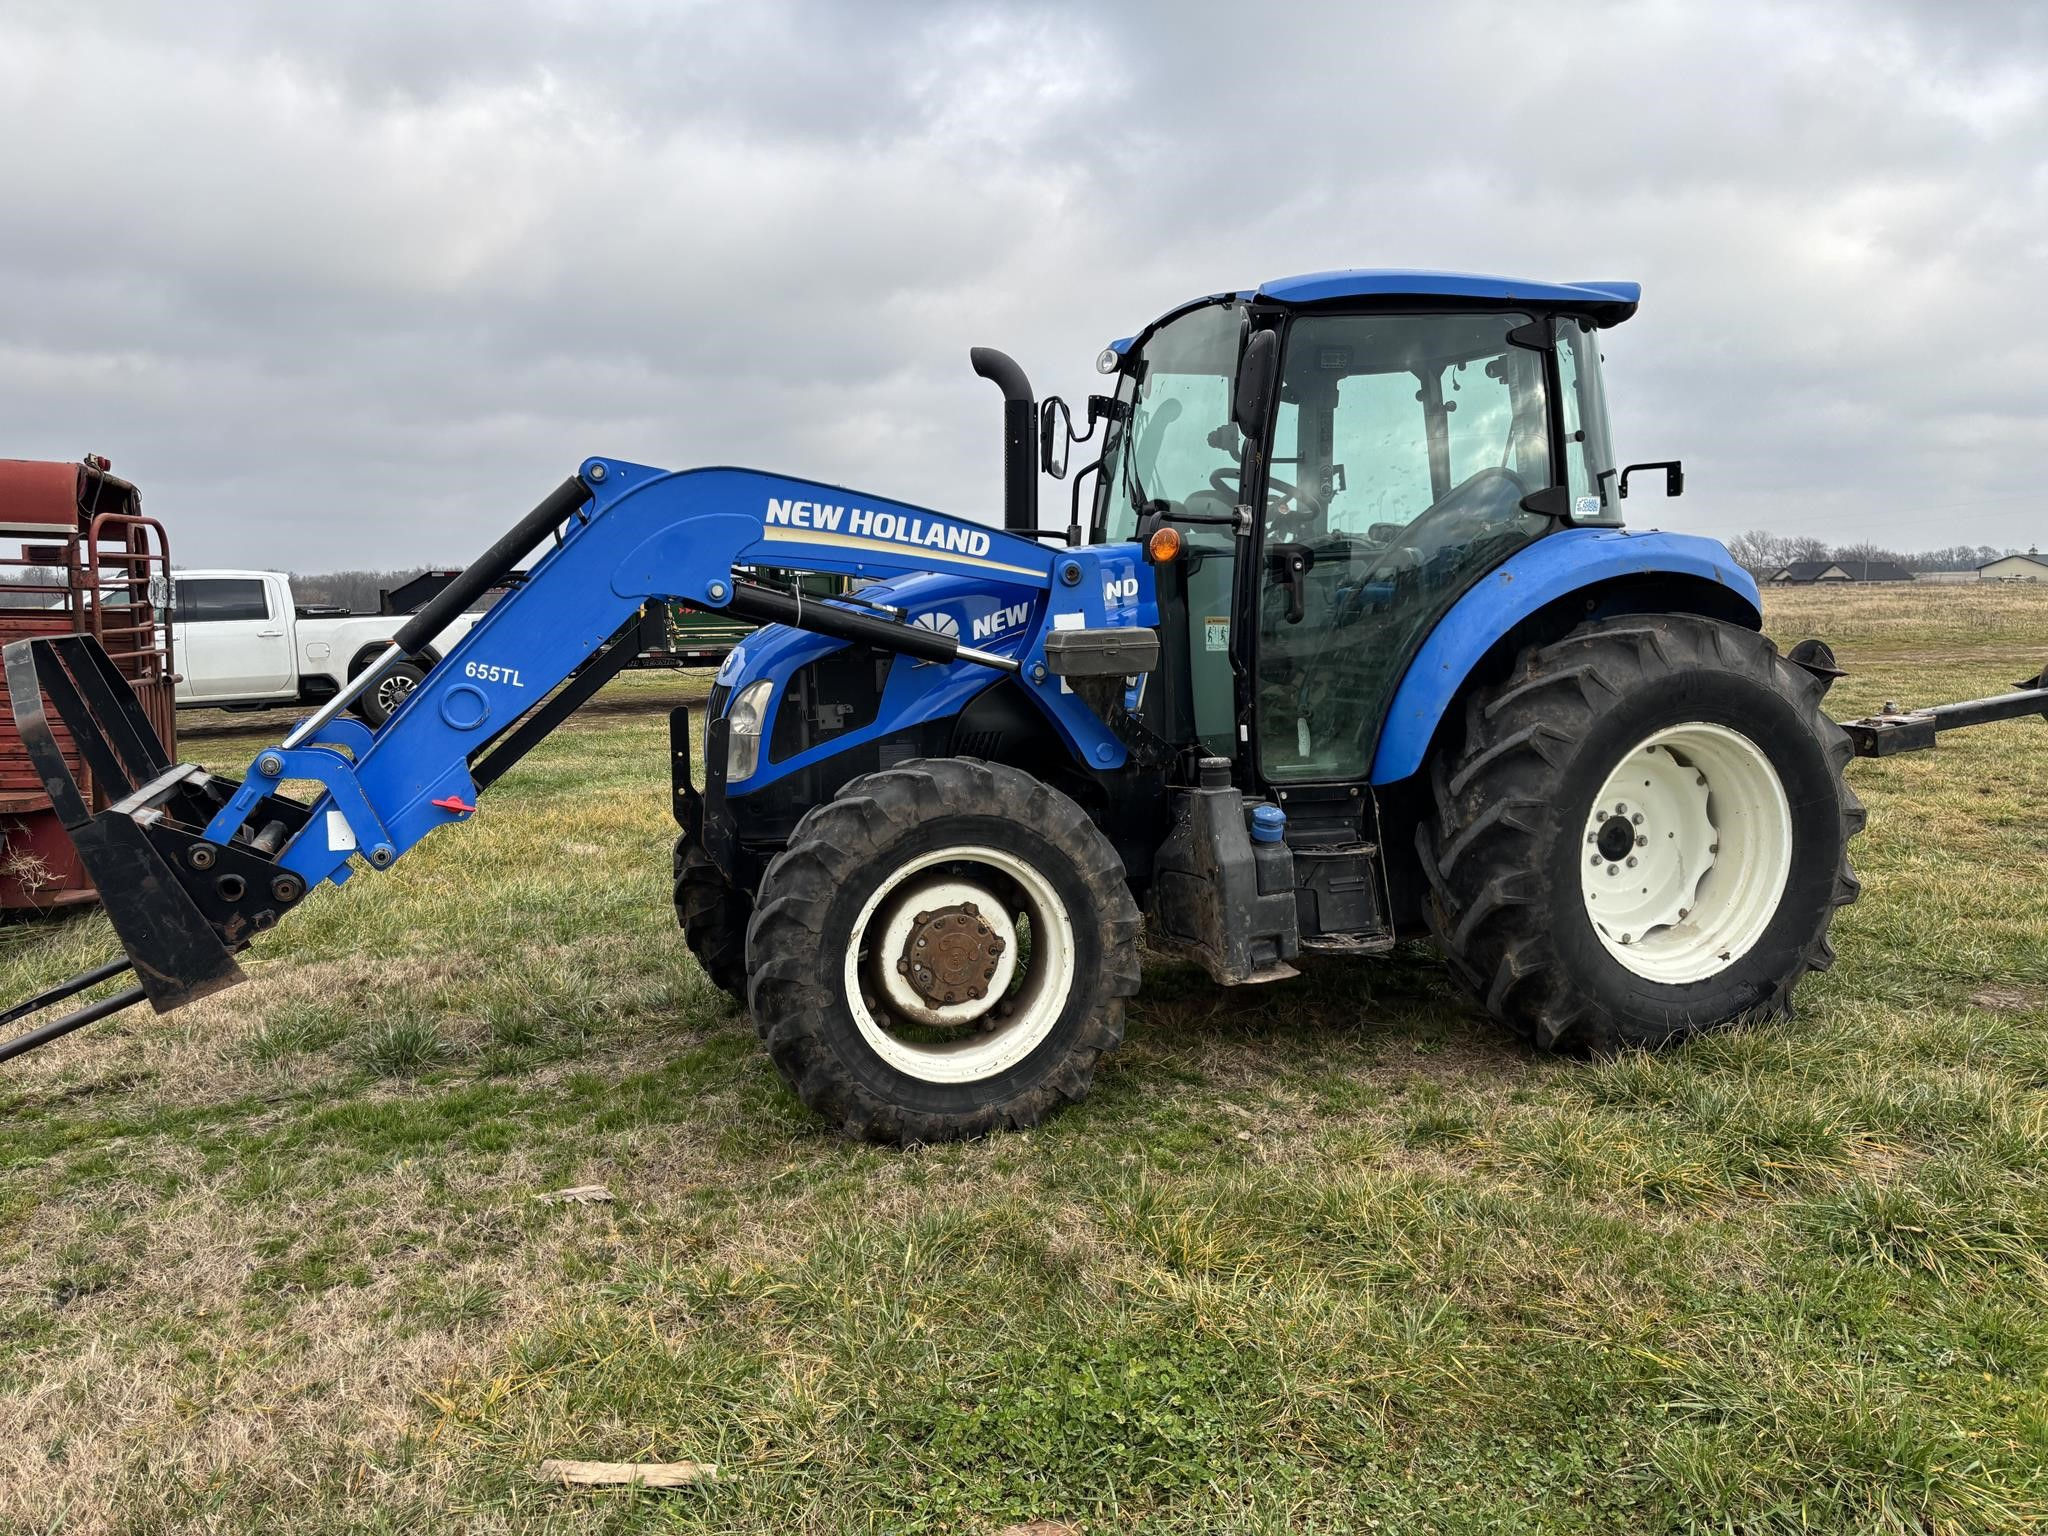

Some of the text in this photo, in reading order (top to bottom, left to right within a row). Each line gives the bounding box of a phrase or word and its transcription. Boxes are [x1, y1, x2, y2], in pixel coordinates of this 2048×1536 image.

[765, 498, 990, 557] NEW HOLLAND
[1103, 578, 1139, 600] ND
[973, 601, 1029, 641] NEW
[465, 661, 524, 687] 655TL
